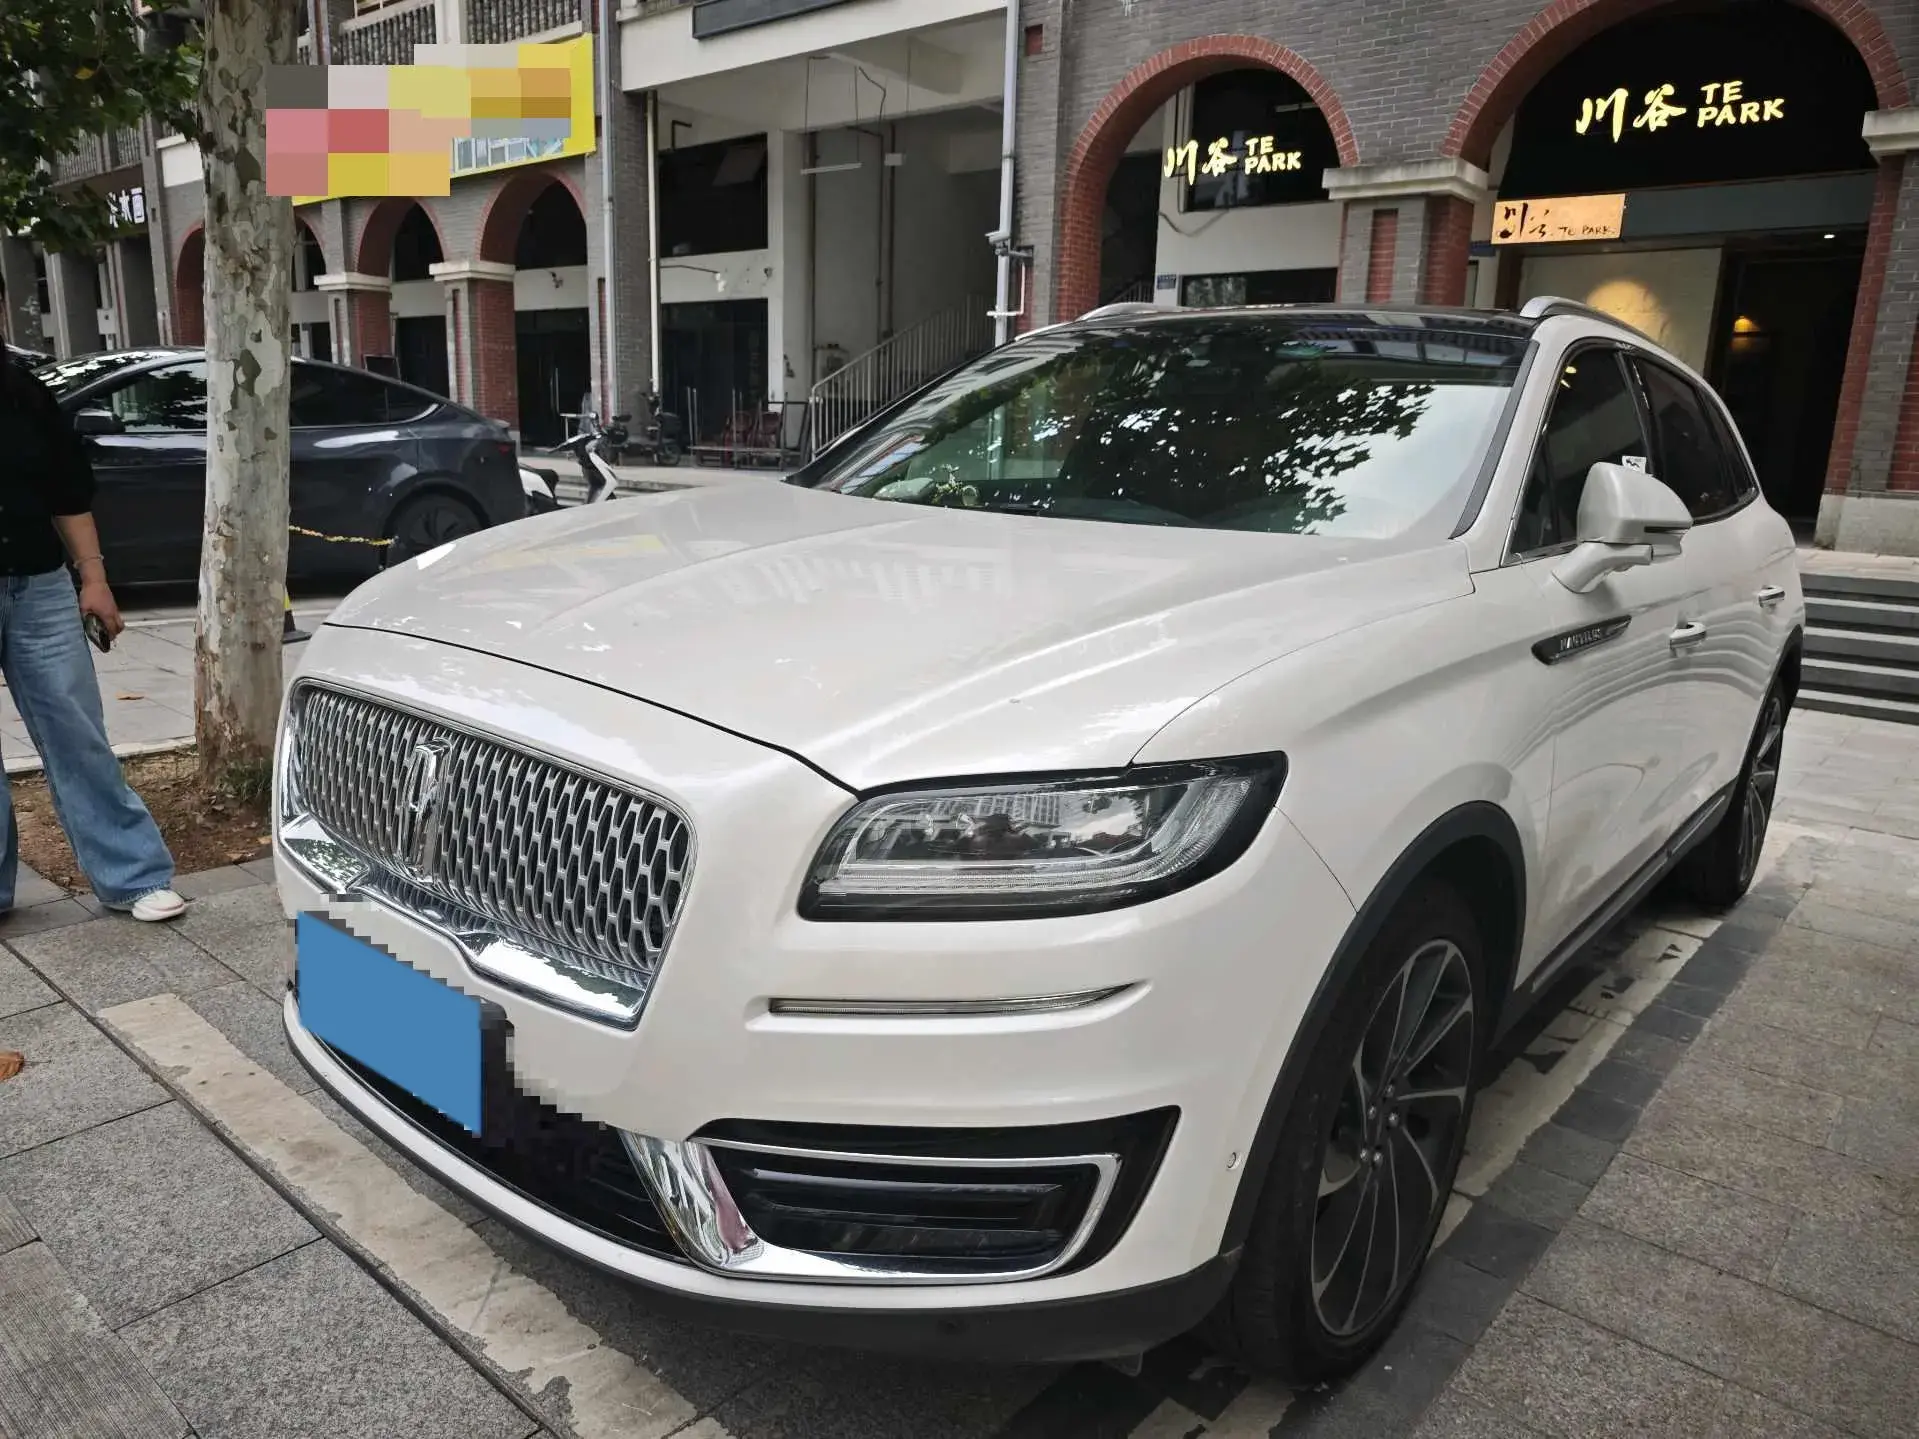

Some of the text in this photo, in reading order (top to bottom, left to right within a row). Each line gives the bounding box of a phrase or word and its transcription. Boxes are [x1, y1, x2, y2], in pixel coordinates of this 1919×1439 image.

[1701, 81, 1743, 105] TE
[1575, 83, 1687, 143] 川谷
[1697, 98, 1785, 128] PARK
[1246, 136, 1274, 157] TE
[1163, 137, 1238, 186] 川谷
[1244, 151, 1302, 175] PARK
